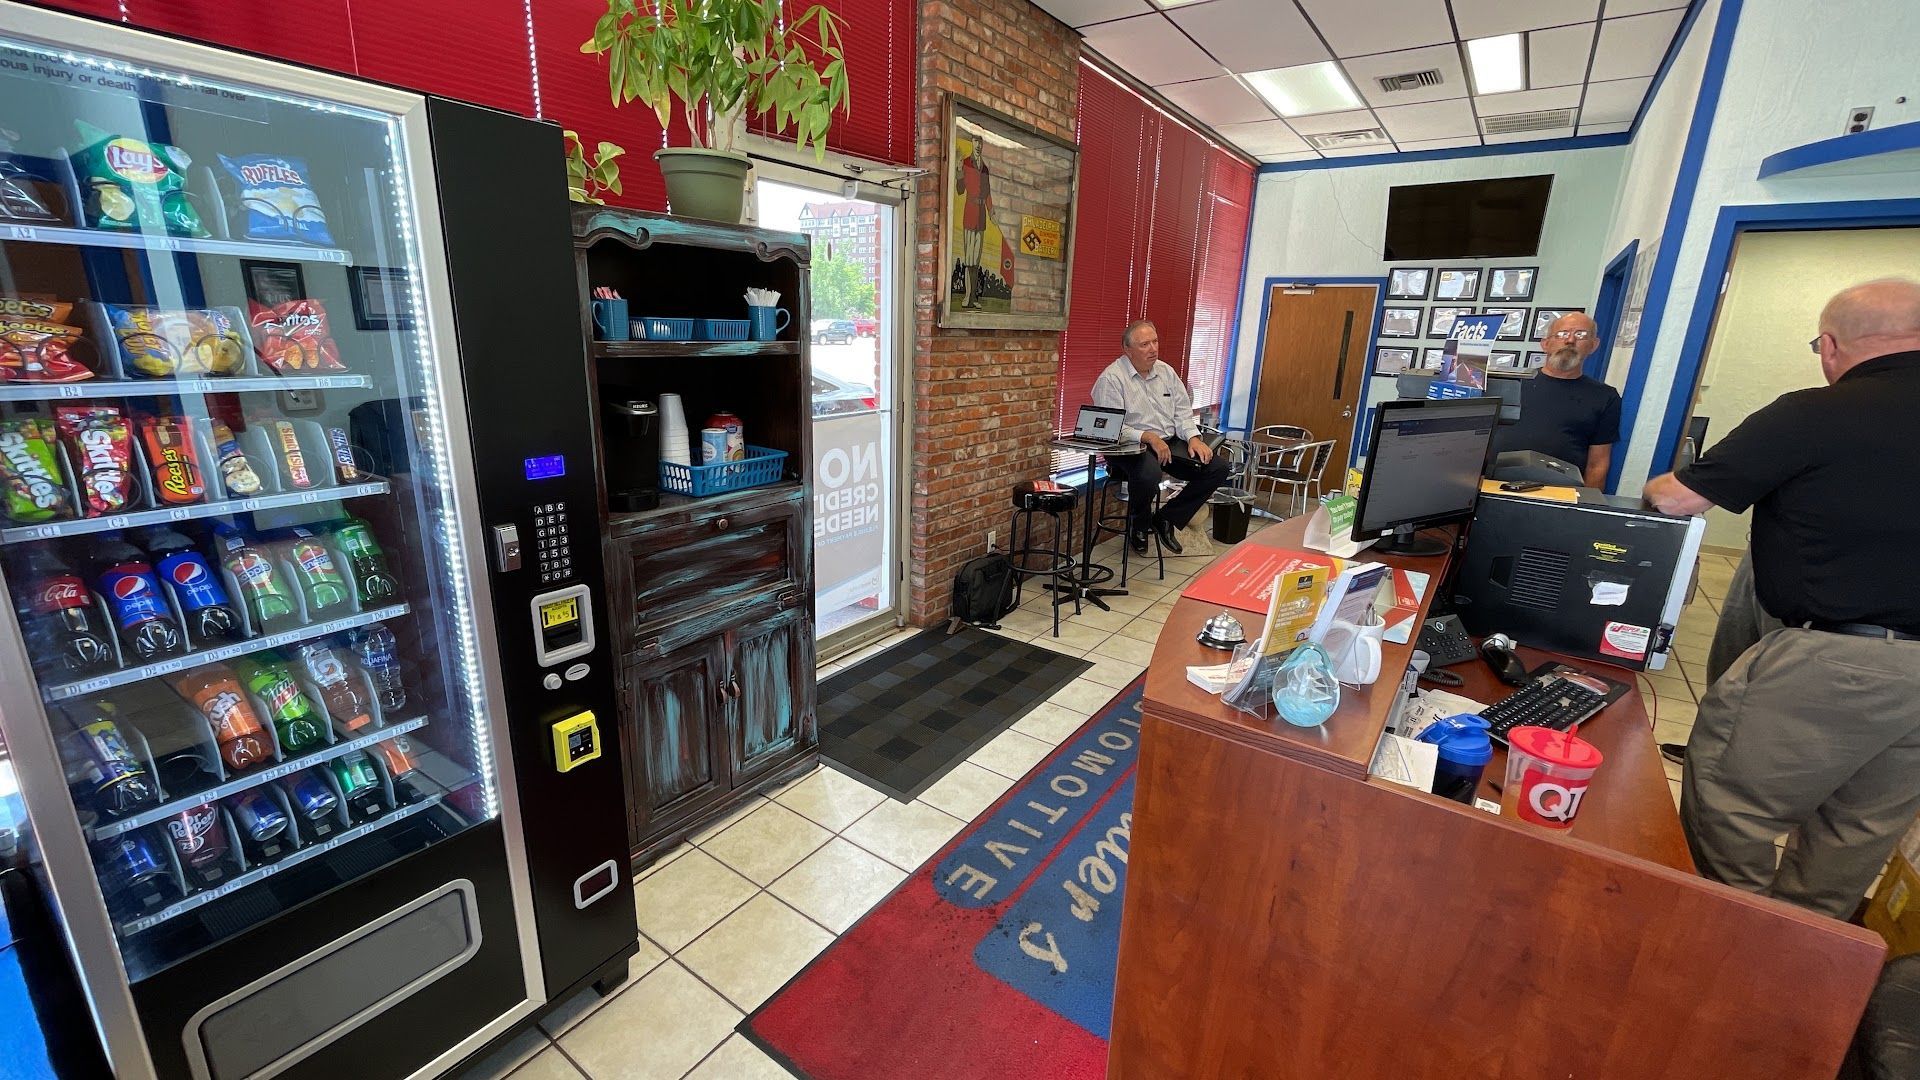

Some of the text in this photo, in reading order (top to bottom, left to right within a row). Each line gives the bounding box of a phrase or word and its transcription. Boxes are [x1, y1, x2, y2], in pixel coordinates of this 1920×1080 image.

[33, 63, 74, 82] injury
[78, 73, 93, 83] or
[222, 89, 247, 102] over
[241, 163, 306, 186] RUFFLES
[1450, 320, 1488, 341] Facts
[65, 387, 79, 397] B2
[164, 447, 188, 496] Reese's
[359, 485, 369, 494] C6
[174, 511, 186, 519] C3
[112, 518, 125, 528] C2
[42, 527, 55, 537] C1
[187, 584, 213, 597] pepsi
[125, 599, 153, 613] pepsi
[209, 652, 219, 661] D3
[145, 667, 157, 677] D2
[70, 685, 81, 695] D1
